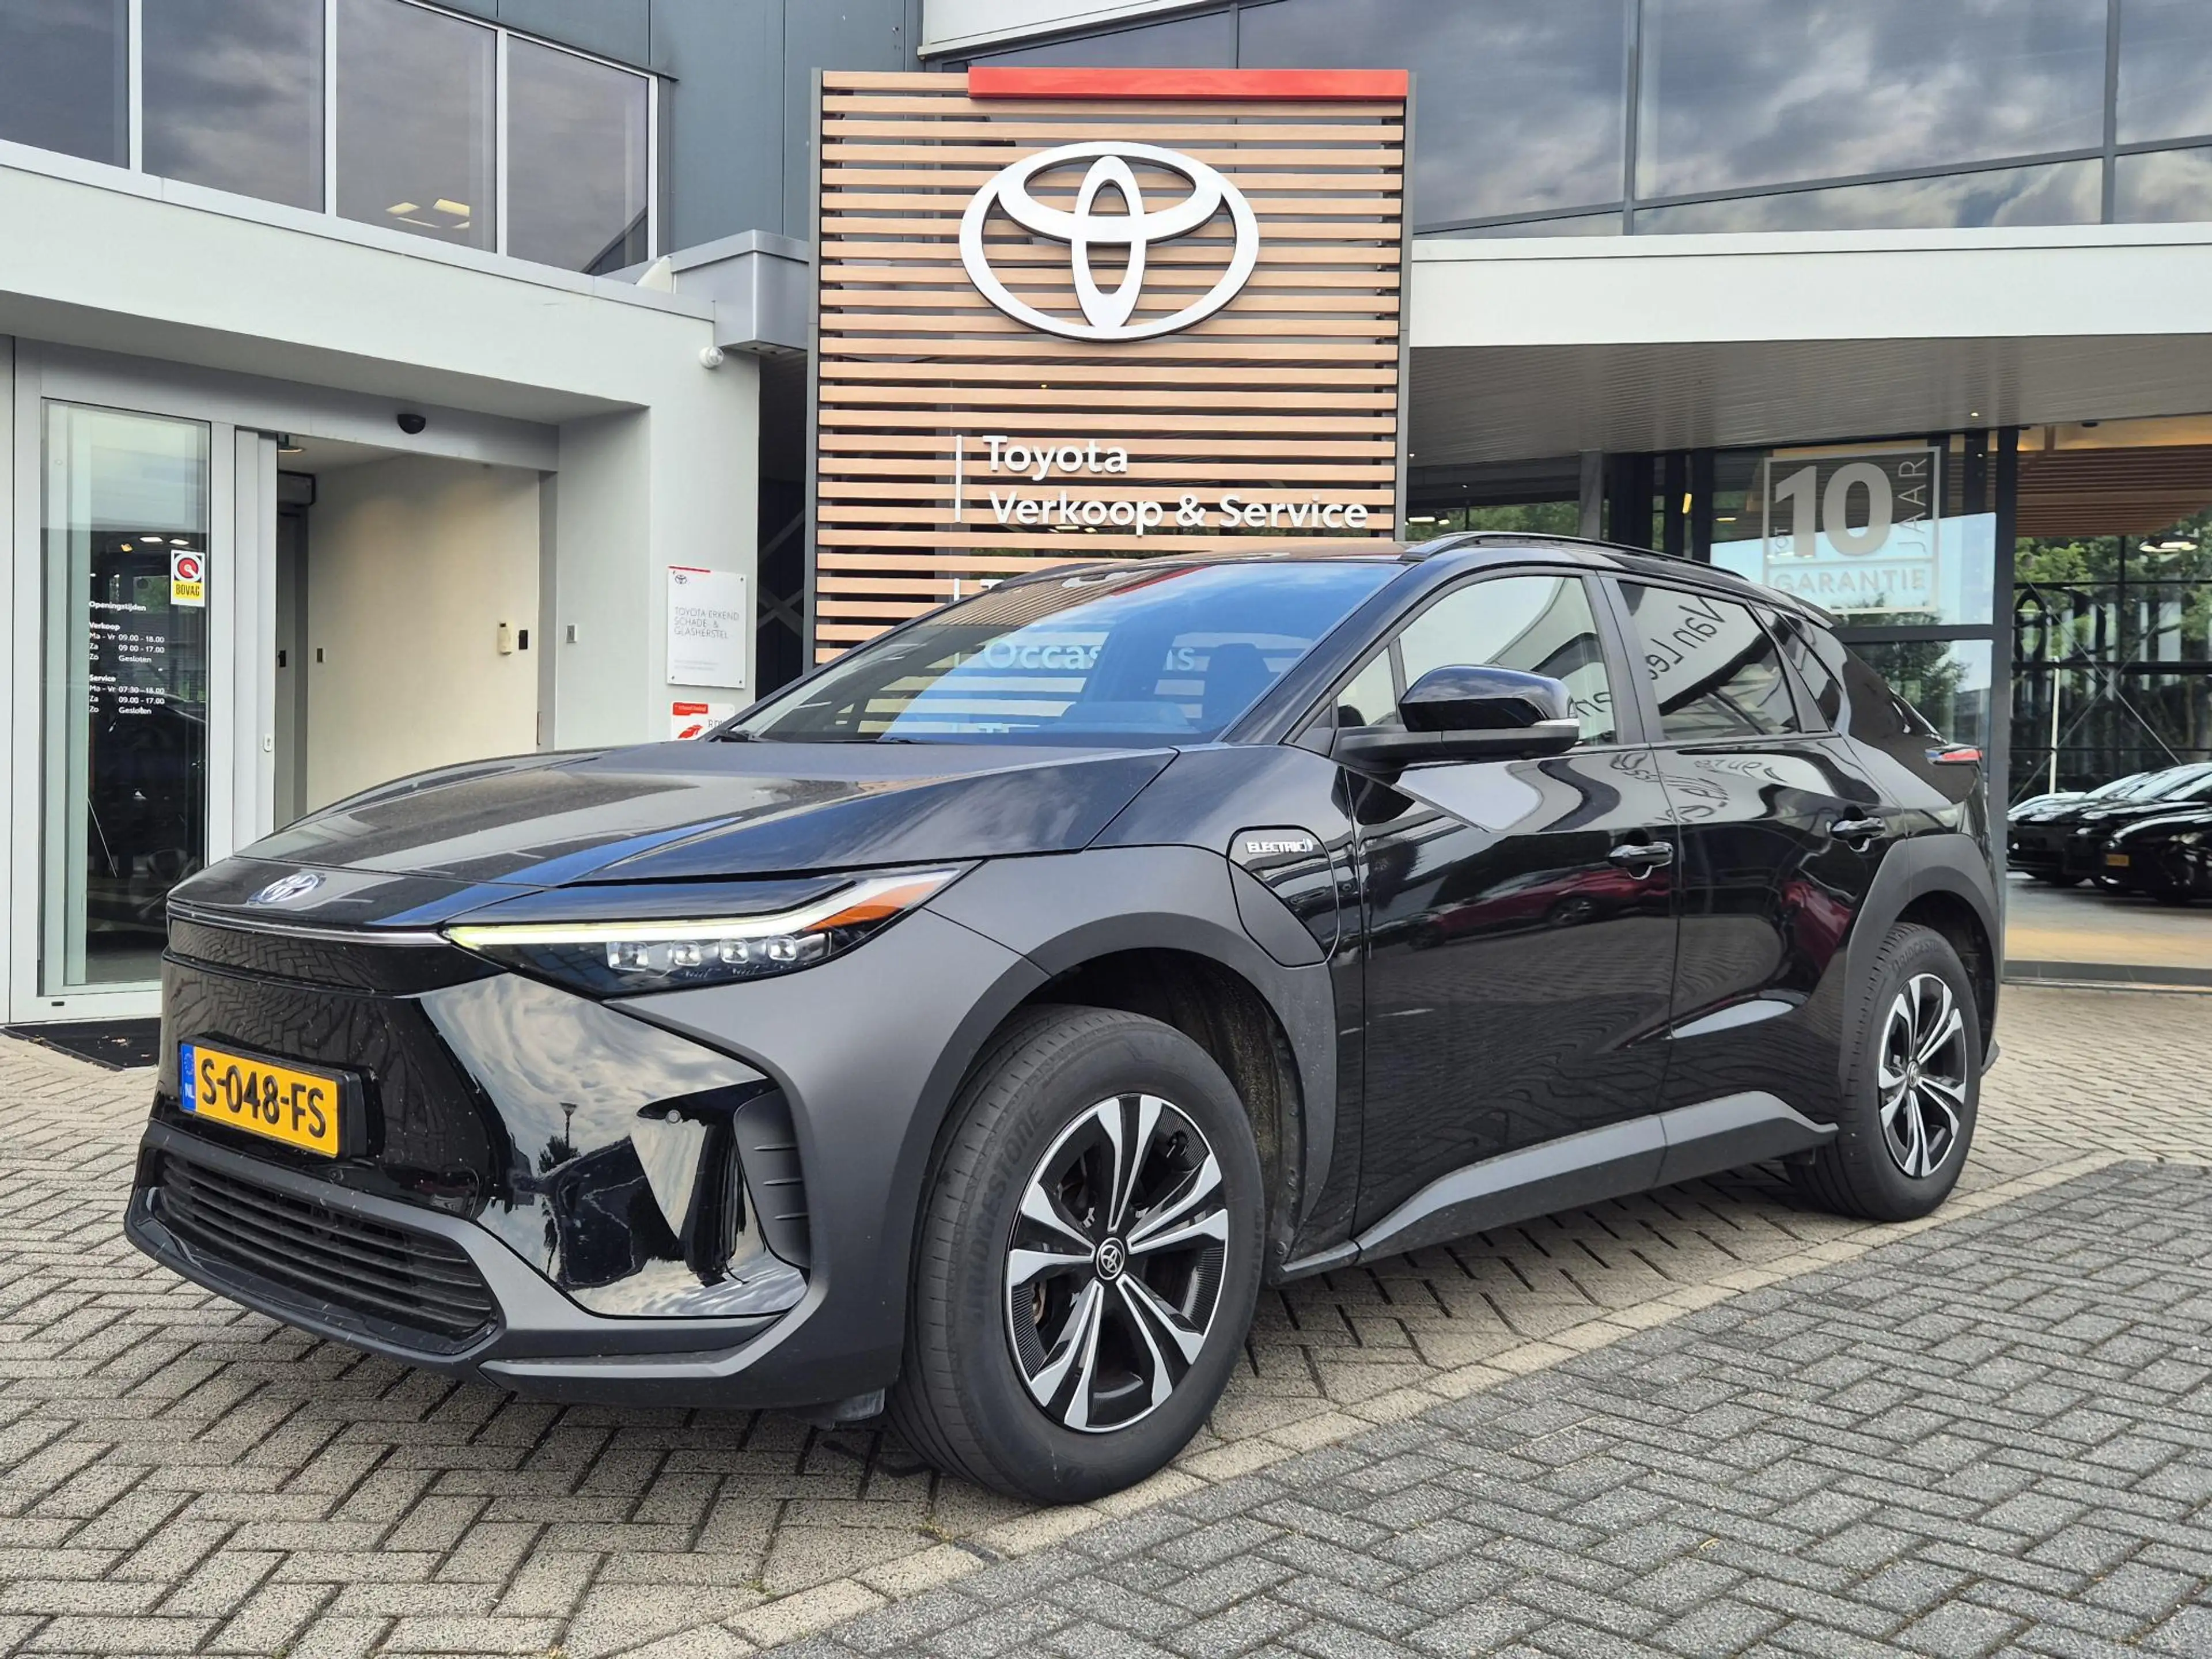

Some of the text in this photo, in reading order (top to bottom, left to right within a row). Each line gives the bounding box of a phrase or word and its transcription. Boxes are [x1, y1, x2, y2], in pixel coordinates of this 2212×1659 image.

[983, 434, 1128, 481] Toyota
[1775, 462, 1893, 557] 10
[1897, 459, 1927, 554] JAAR
[989, 490, 1368, 537] Verkoop & Service
[1774, 568, 1926, 594] GARANTIE
[176, 584, 200, 597] BOVAG
[89, 601, 147, 612] Openingstijden
[675, 607, 740, 621] TOYOTA ERKEND
[89, 622, 121, 632] Verkoop
[674, 626, 729, 639] GLASHERSTEL
[89, 632, 101, 640] Ma
[146, 635, 165, 643] 18.00
[119, 655, 152, 663] Gesloten
[89, 674, 116, 683] Service
[119, 706, 152, 715] Gesloten
[184, 1083, 195, 1099] NL
[201, 1058, 327, 1139] S-048-FS
